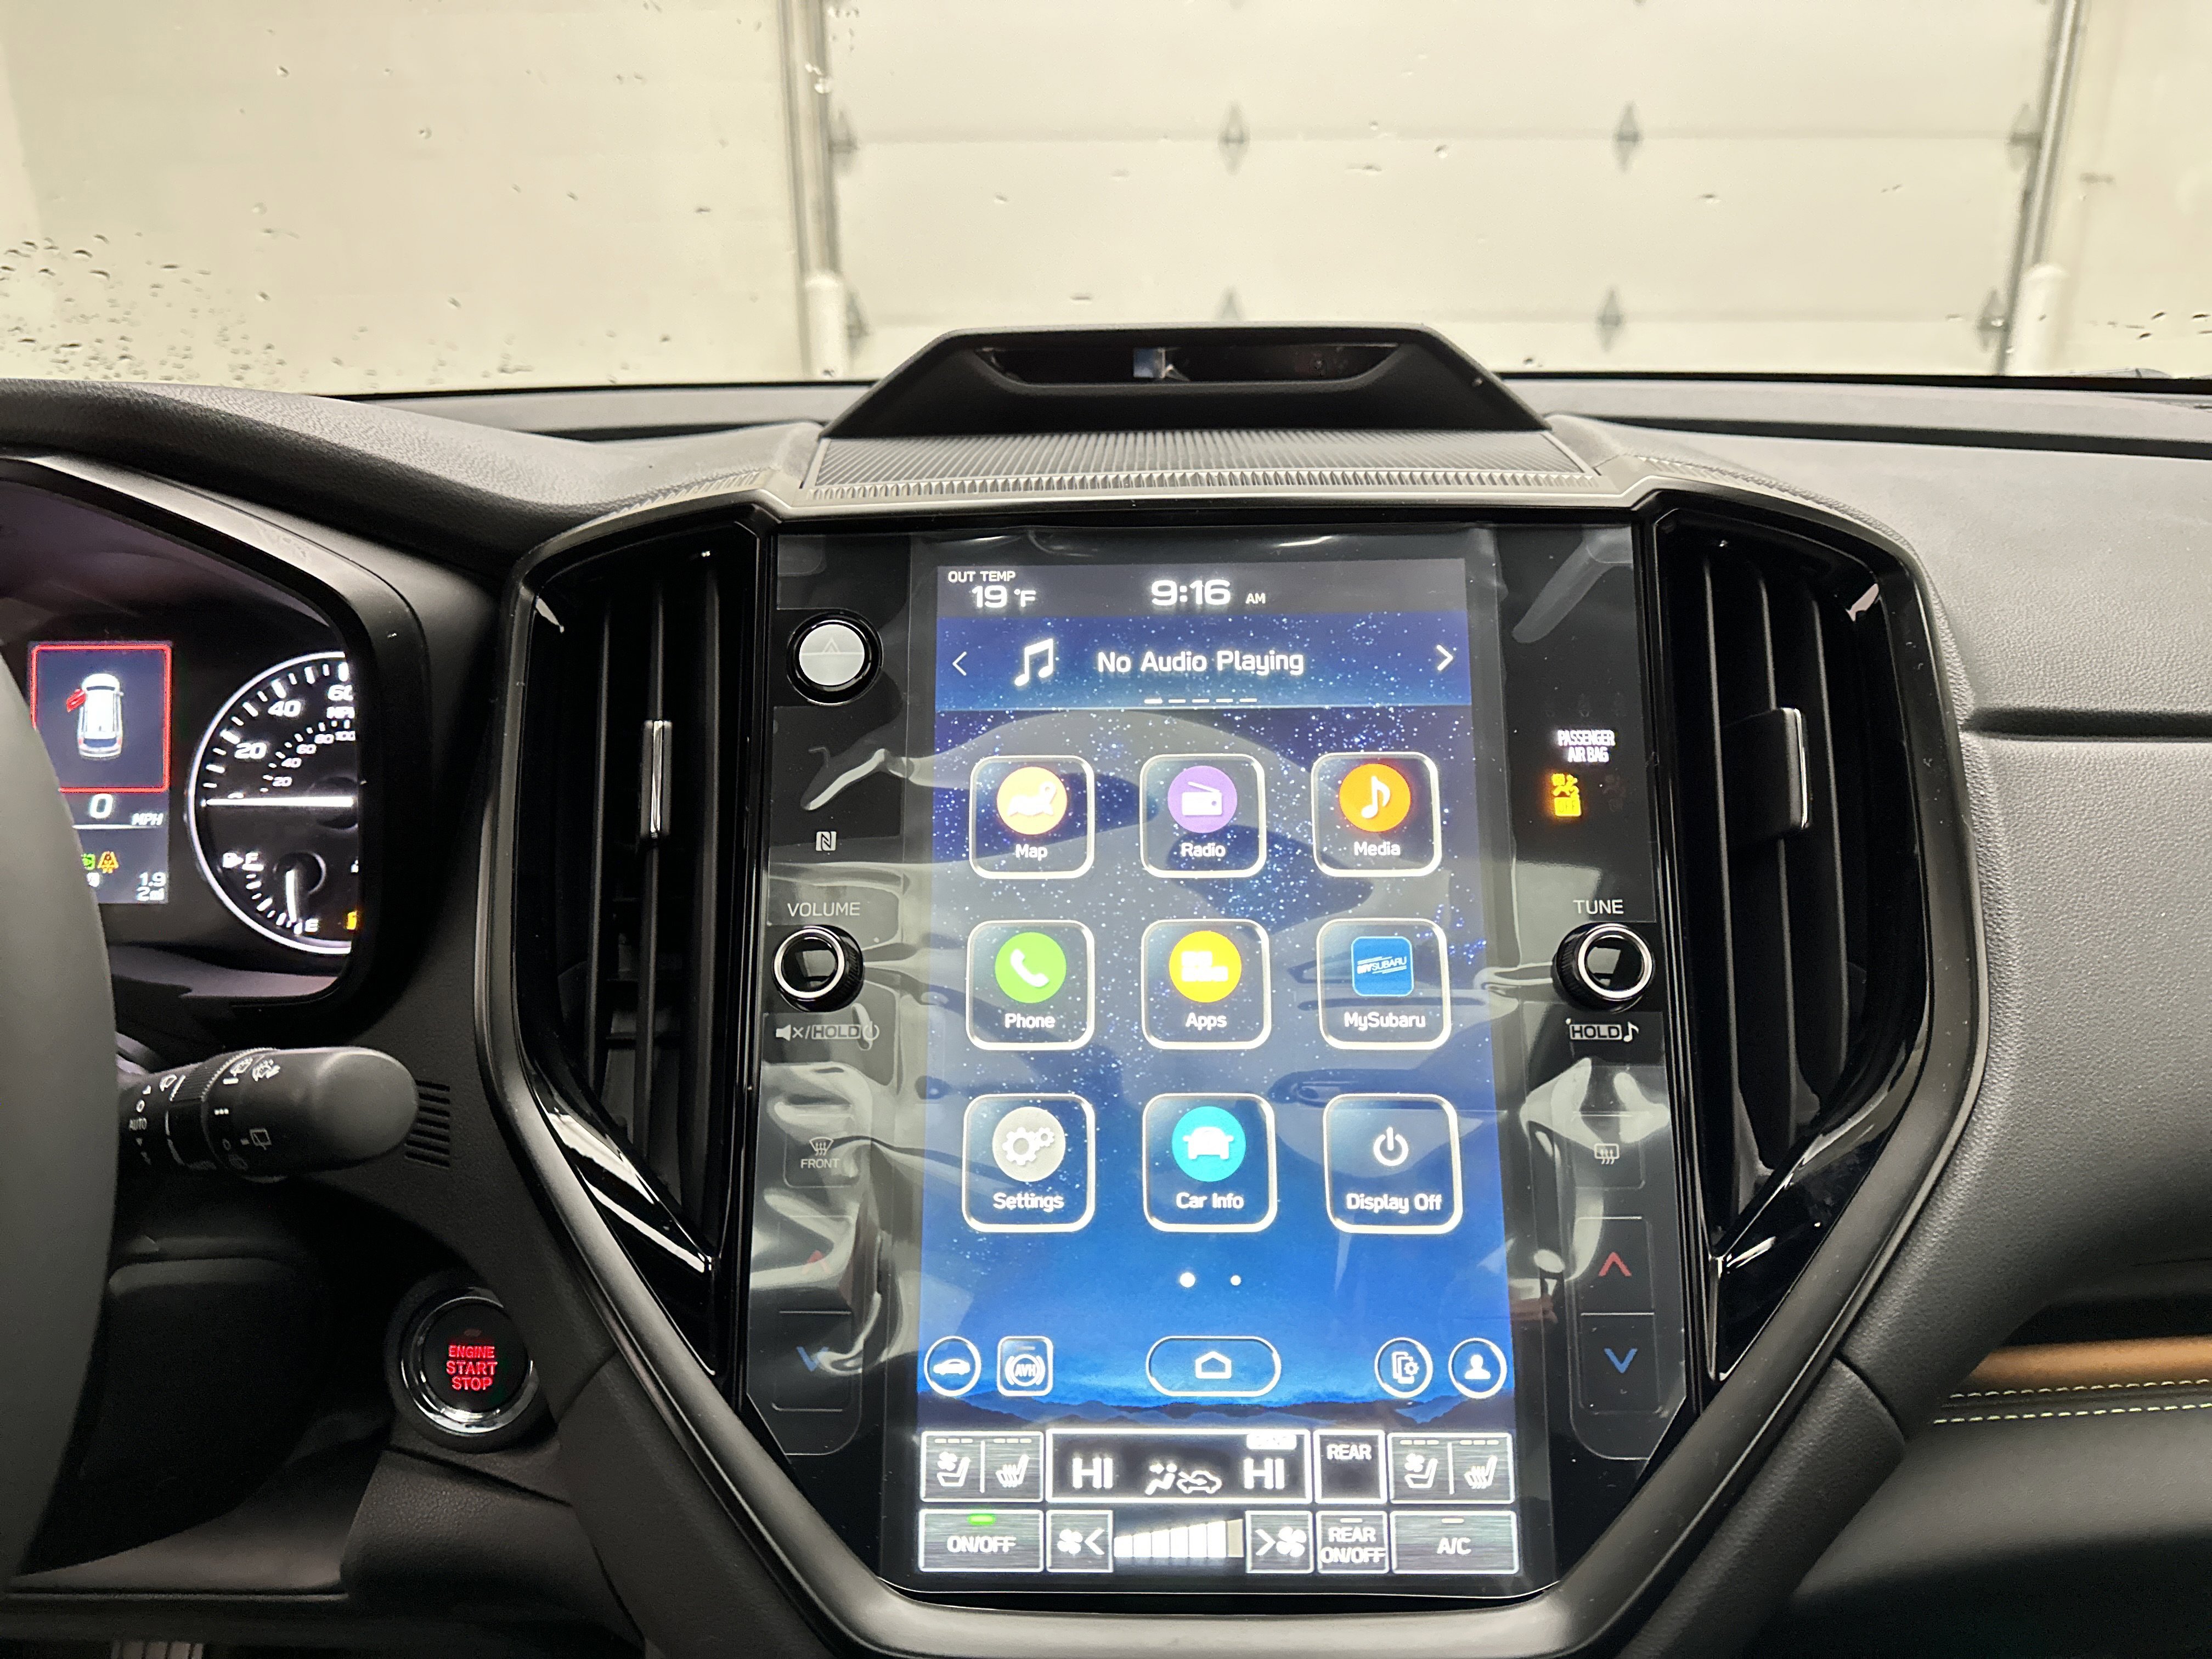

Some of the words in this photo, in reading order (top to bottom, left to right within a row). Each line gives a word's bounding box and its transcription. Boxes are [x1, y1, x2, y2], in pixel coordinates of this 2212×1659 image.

[948, 571, 975, 583] OUT
[980, 571, 1015, 582] TEMP
[972, 585, 1007, 608] 19
[1152, 579, 1231, 605] 9:16
[1245, 592, 1266, 604] AM
[1098, 652, 1131, 672] No
[1141, 651, 1206, 672] Audio
[1217, 650, 1304, 675] Playing
[268, 700, 302, 717] 40
[314, 733, 335, 744] 80
[1558, 729, 1616, 746] PASSENGER
[234, 742, 267, 759] 20
[296, 744, 317, 754] 60
[1567, 747, 1586, 763] AIR
[1587, 747, 1610, 763] BAG
[281, 757, 302, 768] 40
[272, 776, 292, 787] 20
[90, 793, 114, 820] 0
[132, 812, 164, 826] MPH
[1015, 844, 1048, 861] Map
[1181, 842, 1226, 857] Radio
[1353, 841, 1401, 856] Media
[245, 851, 258, 864] F
[787, 902, 861, 918] VOLUME
[1573, 900, 1624, 915] TUNE
[304, 918, 319, 933] E
[1005, 1013, 1056, 1029] Phone
[1186, 1012, 1227, 1029] Apps
[1344, 1011, 1426, 1029] MySubaru
[1571, 1024, 1621, 1039] HOLD
[129, 1118, 148, 1131] AUTO
[800, 1158, 839, 1169] FRONT
[993, 1192, 1064, 1211] Settings
[1176, 1192, 1207, 1209] Car
[1212, 1192, 1244, 1209] Info
[1346, 1193, 1409, 1214] Display
[1414, 1193, 1442, 1210] Off
[448, 1345, 495, 1358] ENGINE
[446, 1360, 498, 1375] START
[1015, 1364, 1036, 1377] AVH
[452, 1375, 493, 1391] STOP
[1327, 1444, 1372, 1460] REAR
[1073, 1458, 1113, 1488] HI
[1244, 1458, 1284, 1488] HI
[1328, 1527, 1376, 1543] REAR
[947, 1536, 1017, 1553] ON/OFF
[1437, 1537, 1471, 1555] A/C
[1320, 1547, 1386, 1564] ON/OFF
